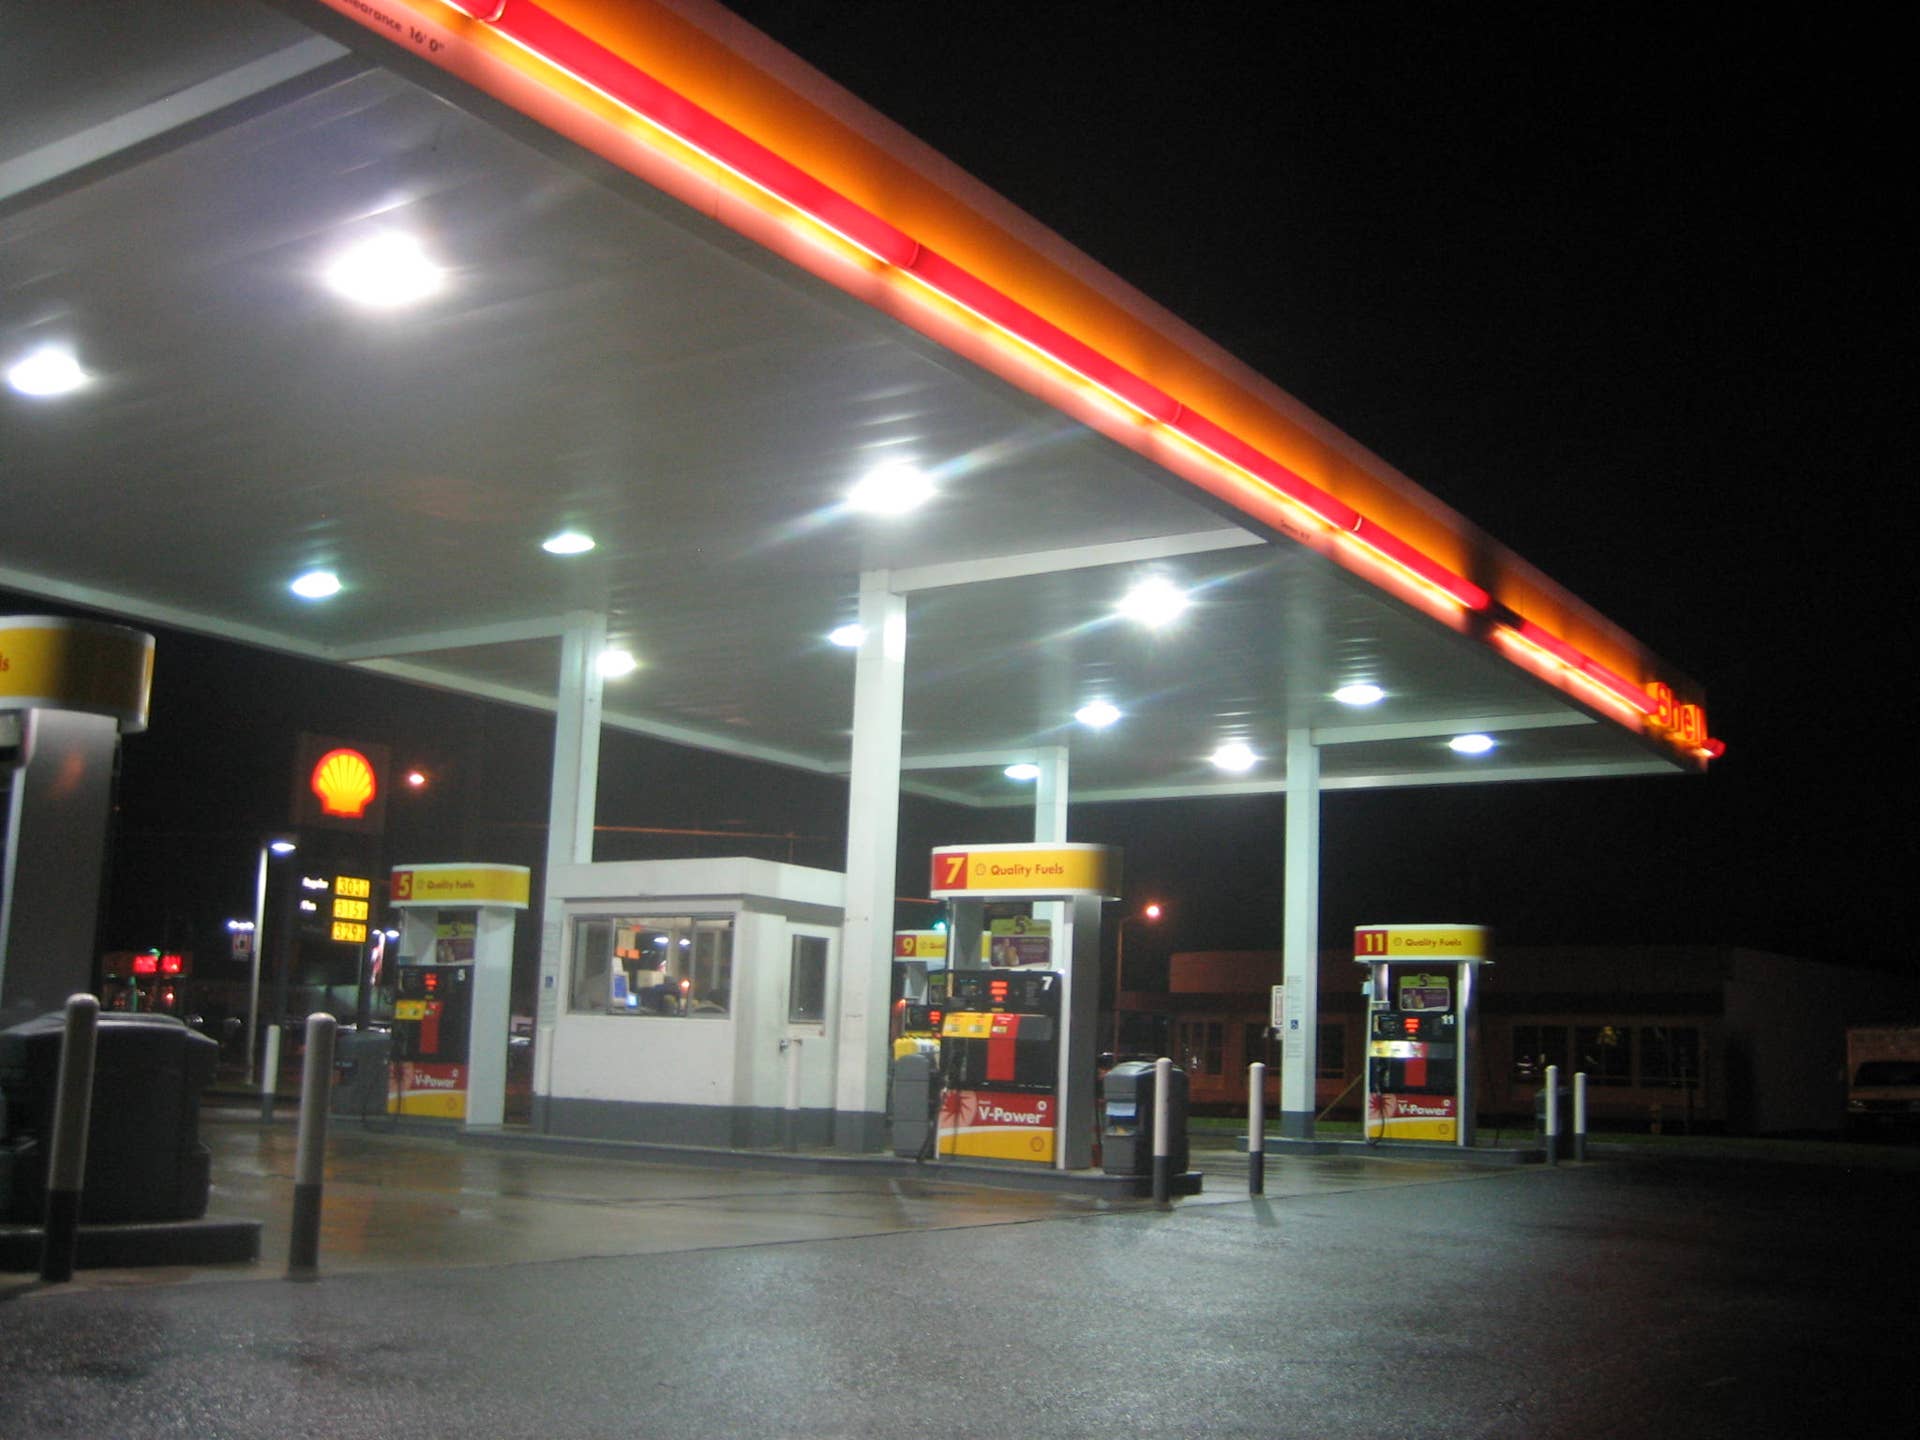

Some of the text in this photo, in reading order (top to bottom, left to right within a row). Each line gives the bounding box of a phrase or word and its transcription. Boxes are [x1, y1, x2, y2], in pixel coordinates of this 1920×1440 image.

[343, 0, 401, 32] earance
[945, 856, 1064, 885] 7 Quality Fuels
[398, 874, 412, 897] 5
[903, 937, 915, 954] 9
[1364, 933, 1462, 953] 11 Quality Fuels
[1041, 975, 1053, 991] 7
[1441, 1014, 1455, 1025] 11
[415, 1072, 456, 1090] V-Power
[978, 1105, 1043, 1124] V-Power
[1398, 1103, 1449, 1116] V-Power
